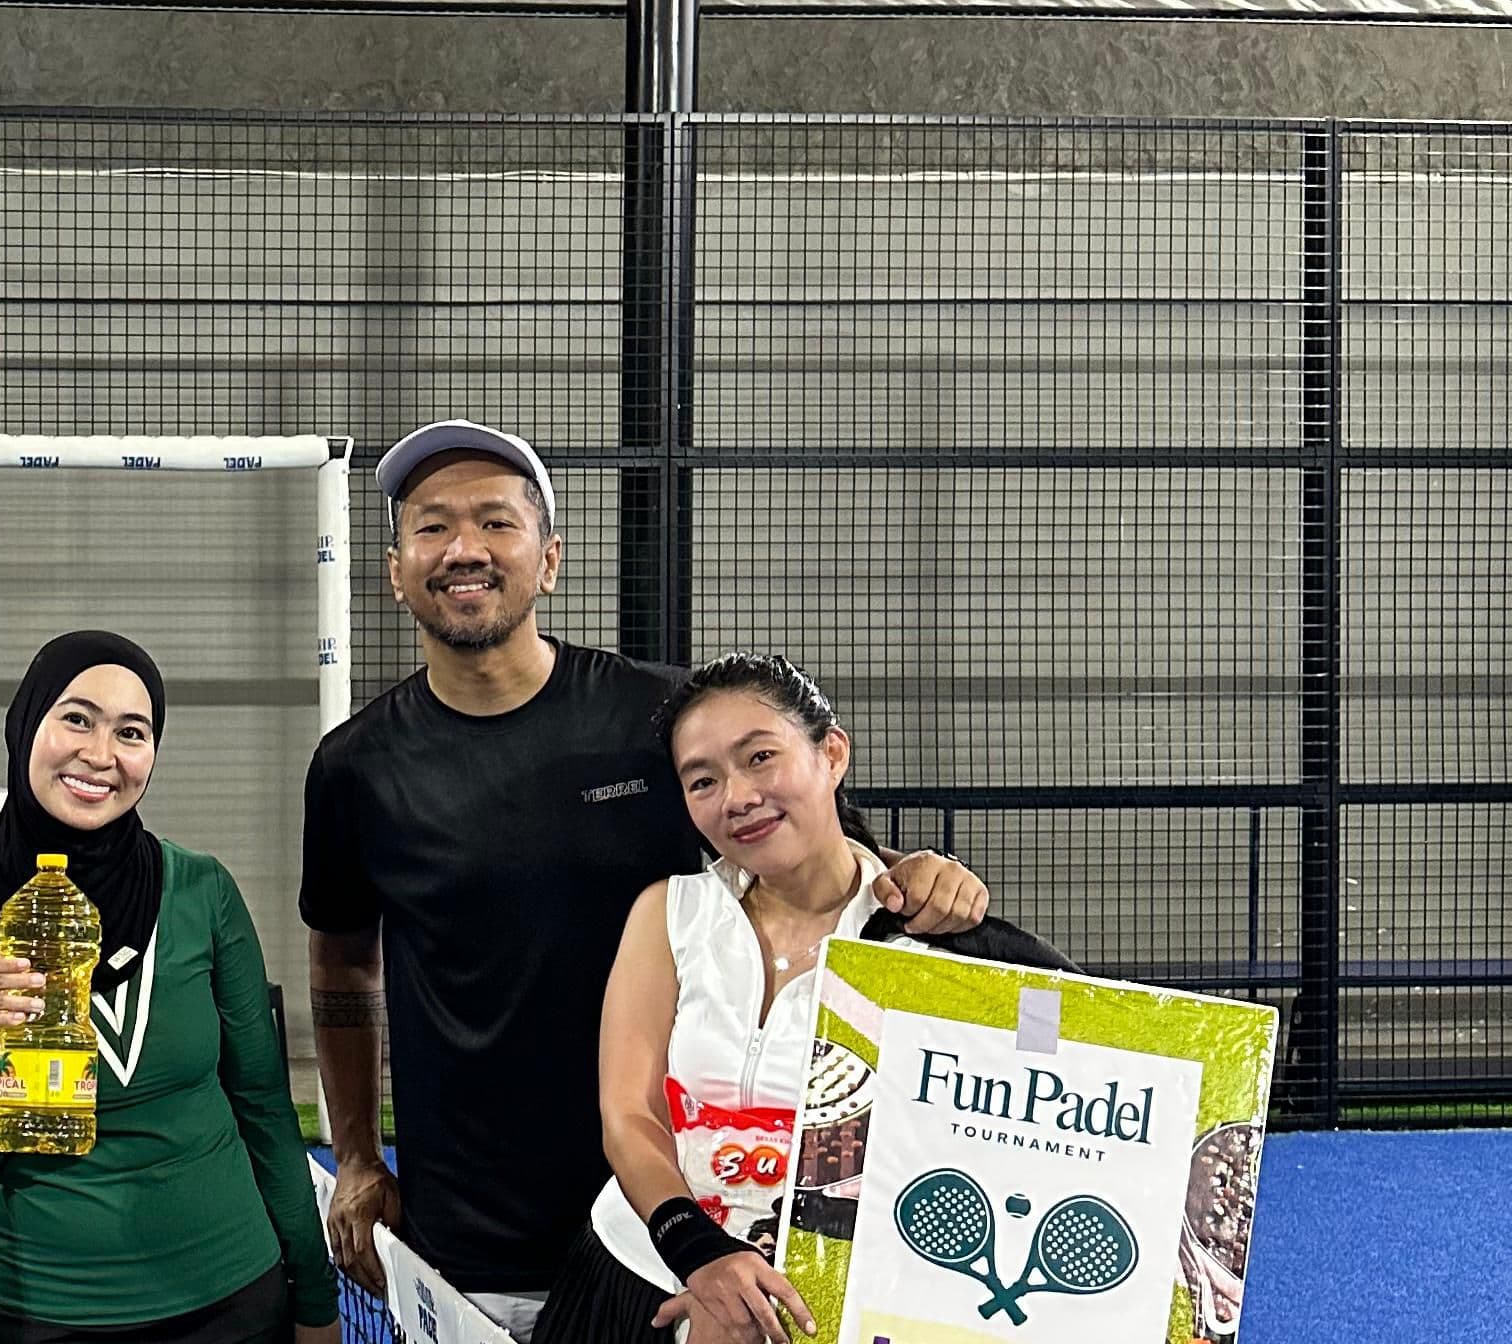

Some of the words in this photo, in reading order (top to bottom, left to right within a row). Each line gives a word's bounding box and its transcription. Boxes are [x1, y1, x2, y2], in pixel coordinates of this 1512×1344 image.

[20, 456, 59, 468] PADEL
[122, 456, 161, 468] PADEL
[224, 456, 262, 468] PADEL
[912, 1048, 1009, 1112] Fun
[1021, 1067, 1156, 1144] Padel
[950, 1122, 1105, 1162] TOURNAMENT
